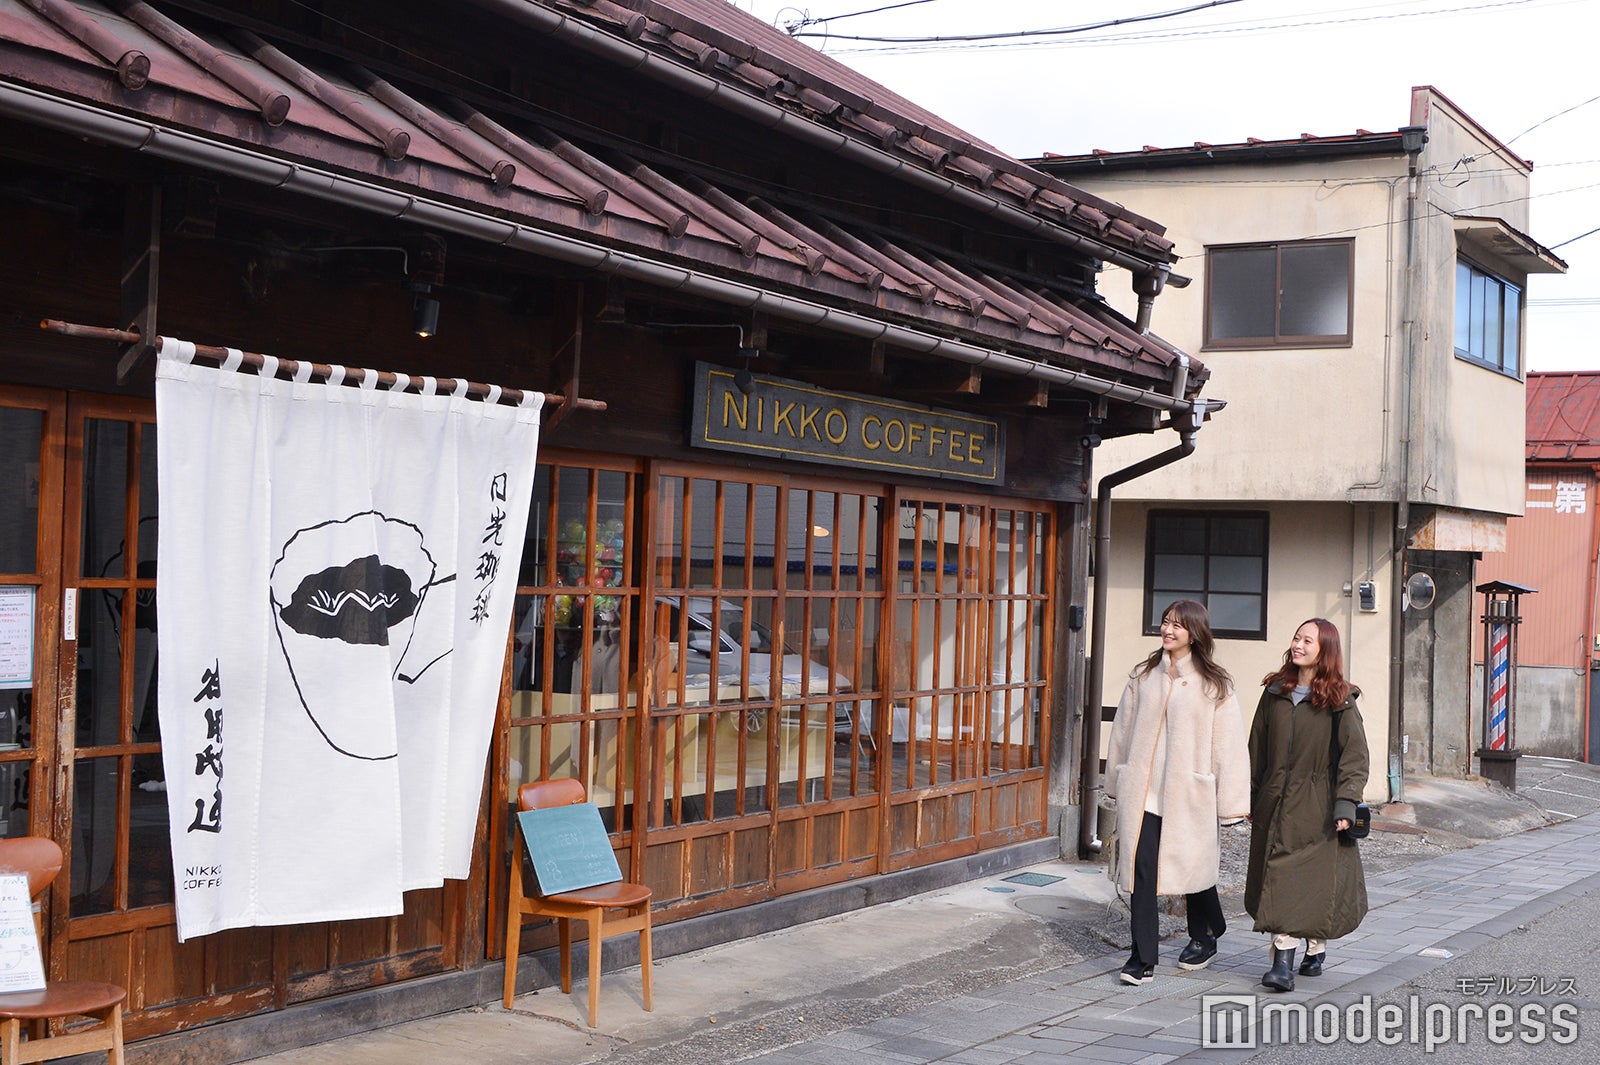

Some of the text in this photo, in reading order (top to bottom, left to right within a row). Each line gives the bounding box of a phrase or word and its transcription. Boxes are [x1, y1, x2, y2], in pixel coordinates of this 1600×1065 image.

[723, 391, 985, 465] NIKKO COFFEE
[184, 878, 222, 890] COFFE
